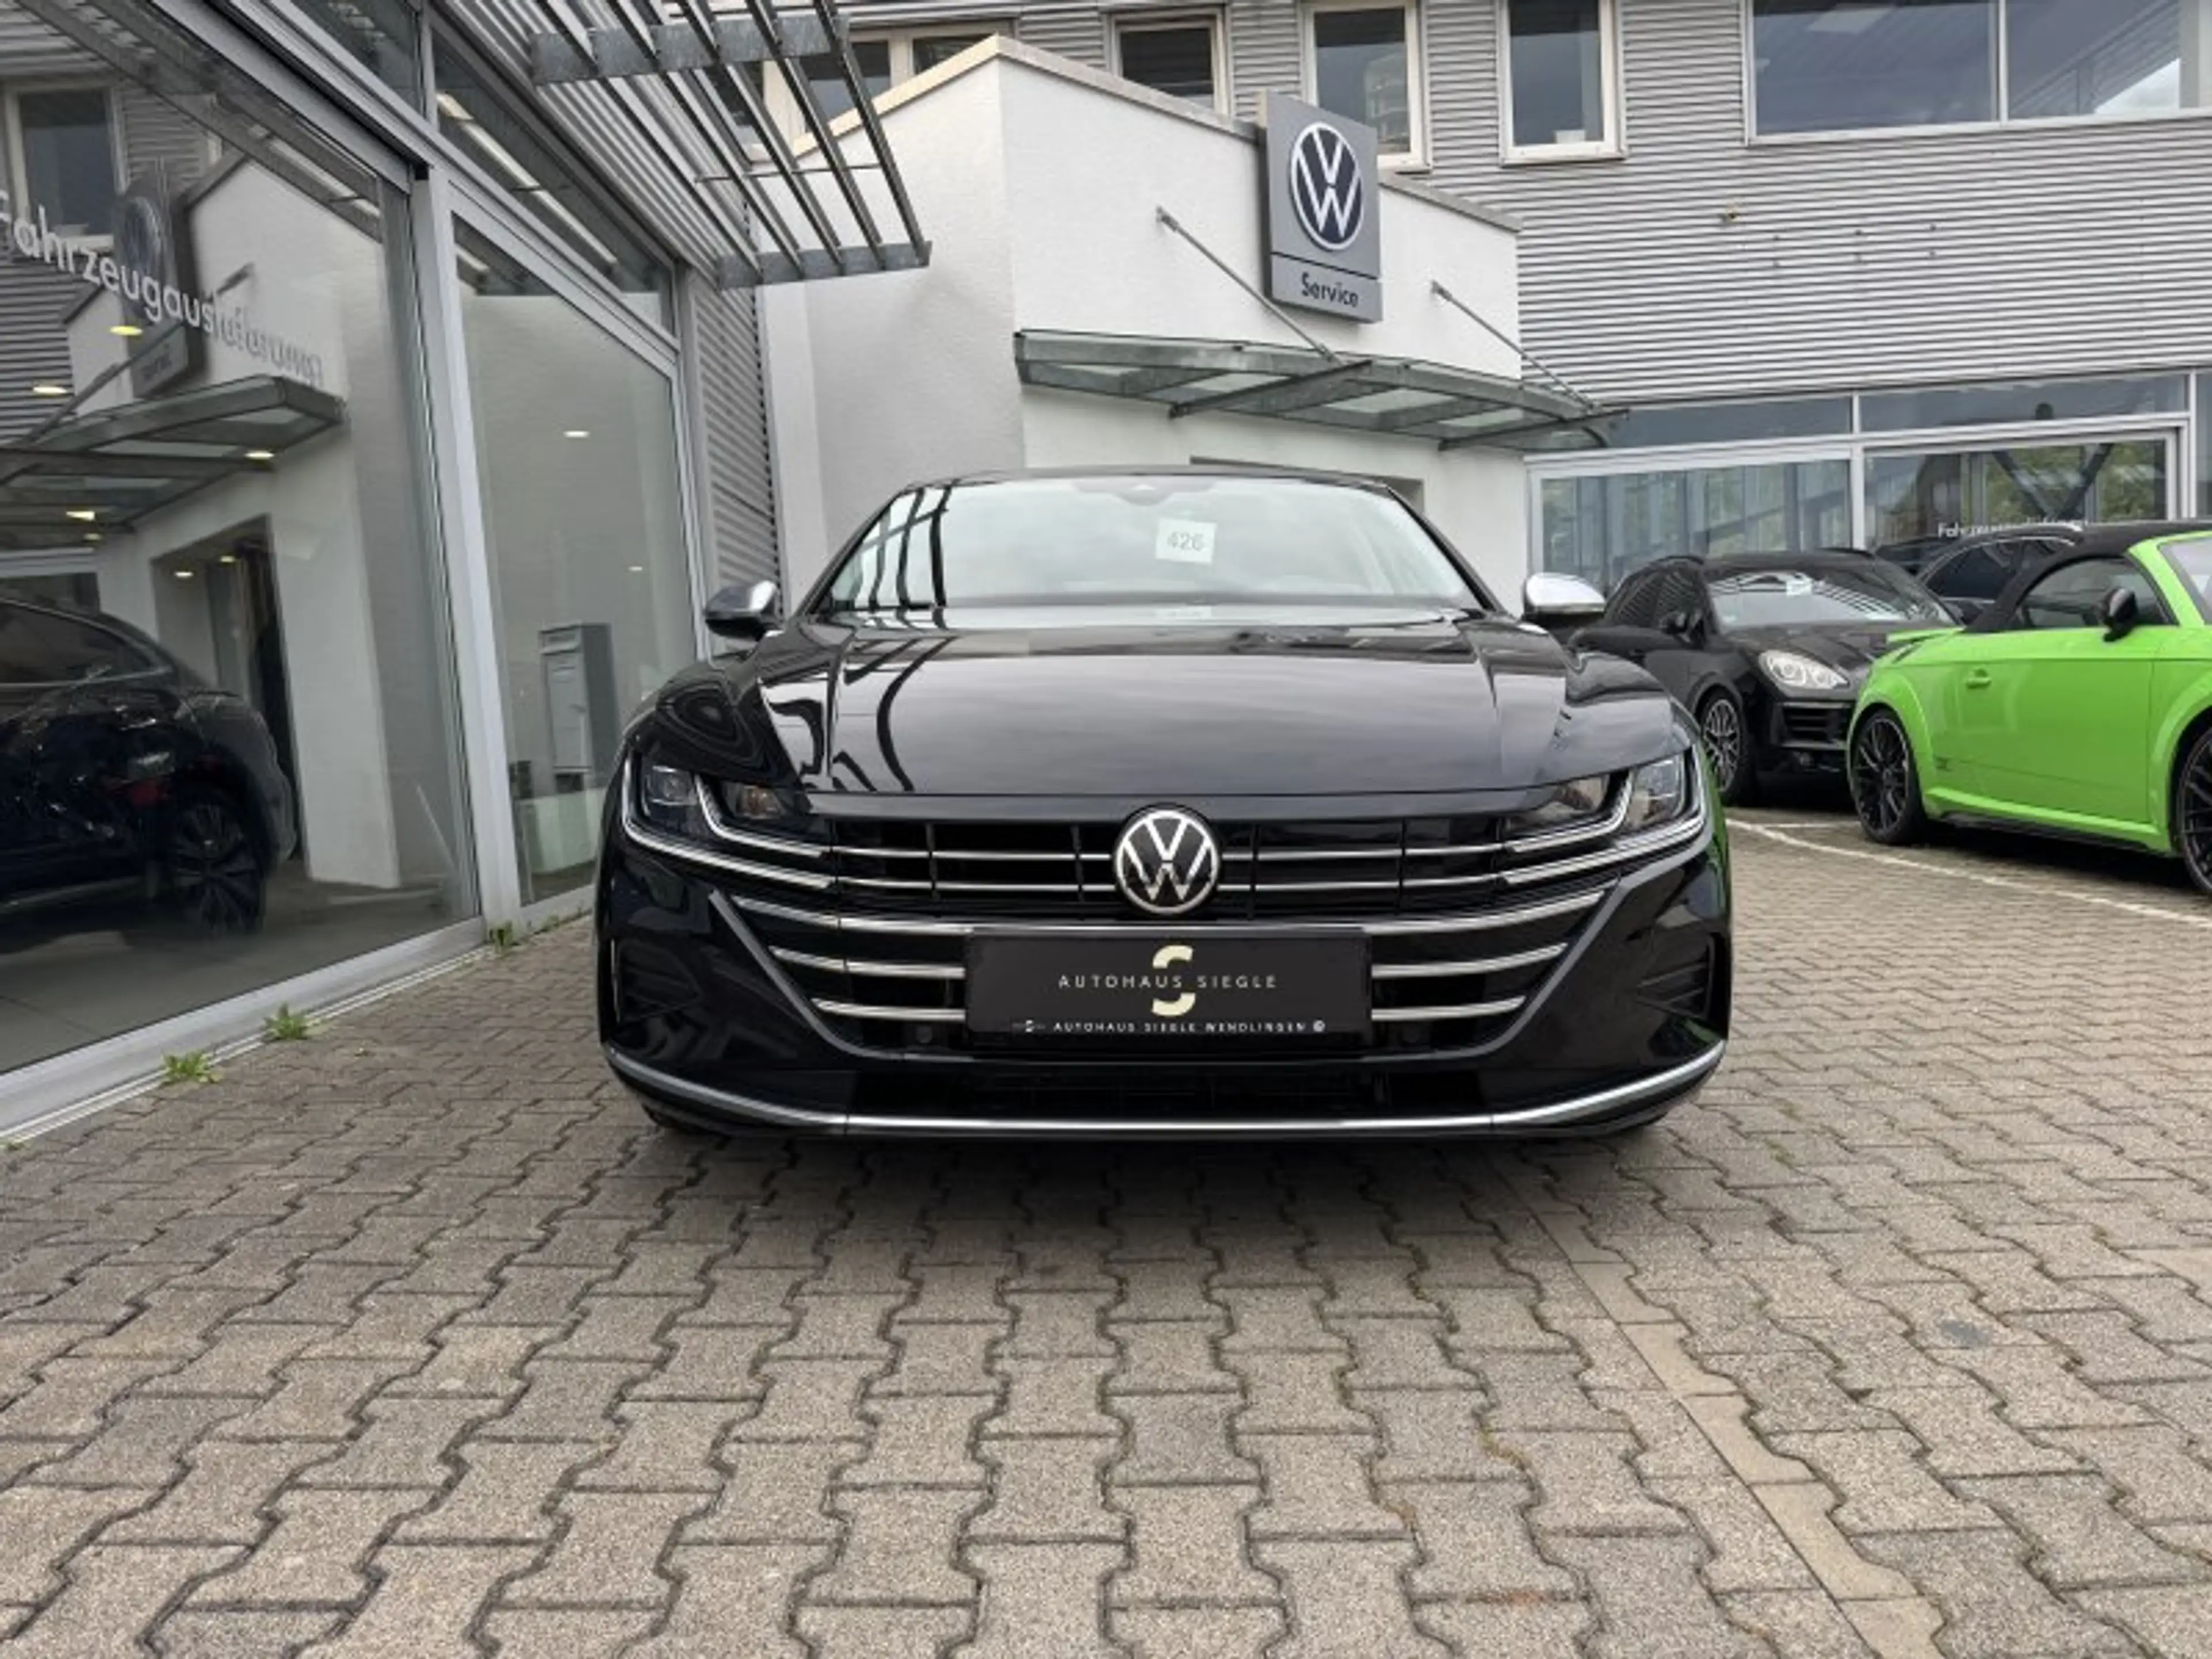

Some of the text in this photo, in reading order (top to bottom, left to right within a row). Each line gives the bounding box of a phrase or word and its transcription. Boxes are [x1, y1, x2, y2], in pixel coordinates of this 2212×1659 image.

[1301, 271, 1359, 308] Service
[1166, 531, 1205, 552] 426
[1058, 974, 1277, 989] AUTOHAUS SIEGLE
[1053, 1021, 1135, 1033] AUTOHAUS
[1144, 1021, 1196, 1033] SIEGLE
[1206, 1021, 1306, 1033] WENDLINGEN
